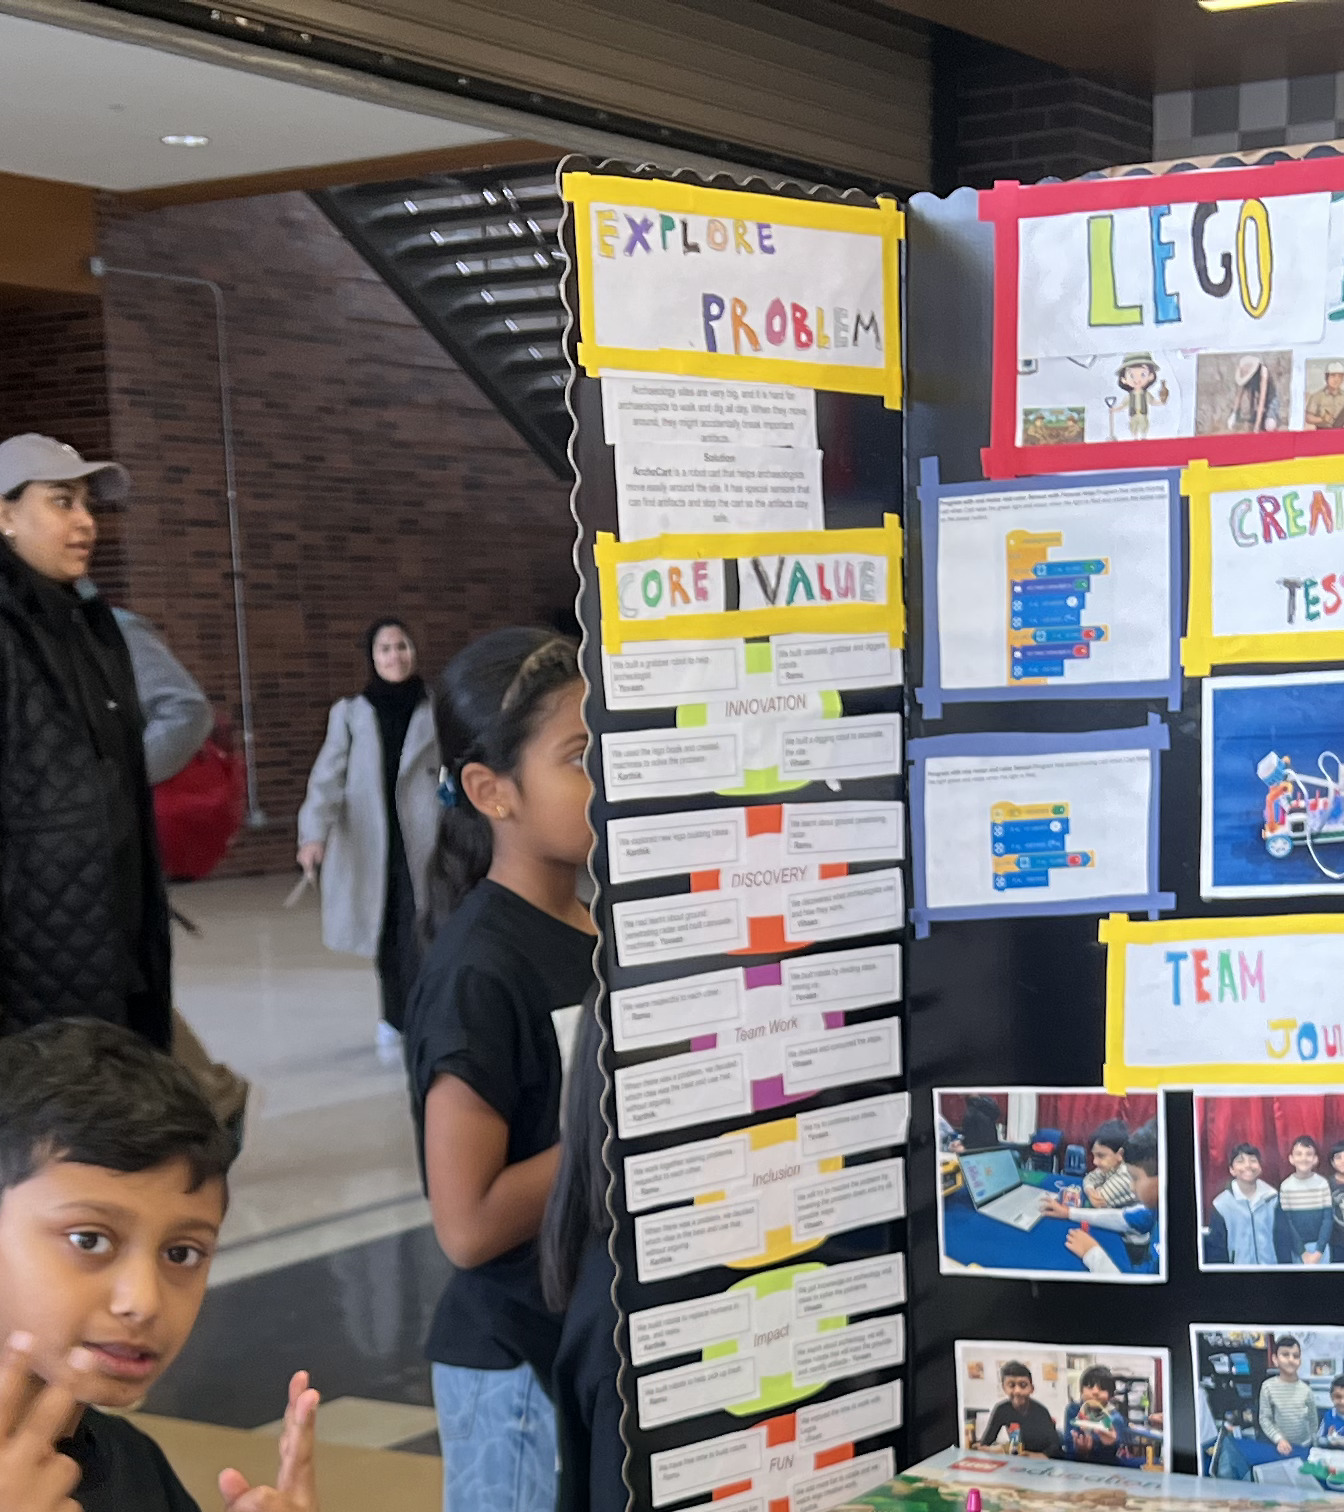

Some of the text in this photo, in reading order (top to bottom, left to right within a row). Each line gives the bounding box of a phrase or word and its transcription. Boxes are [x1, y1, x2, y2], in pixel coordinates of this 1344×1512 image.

[595, 208, 776, 260] EXPLORE
[1087, 197, 1273, 326] LEGO
[701, 292, 884, 355] PROBLEM
[617, 555, 877, 618] CORE VALUE
[724, 693, 807, 718] INNOVATION
[731, 865, 808, 888] DISCOVERY
[1165, 947, 1267, 1006] TEAM
[734, 1015, 799, 1042] Team Work
[752, 1163, 801, 1188] Inclusion
[753, 1323, 791, 1348] Impact
[769, 1454, 795, 1474] FUN
